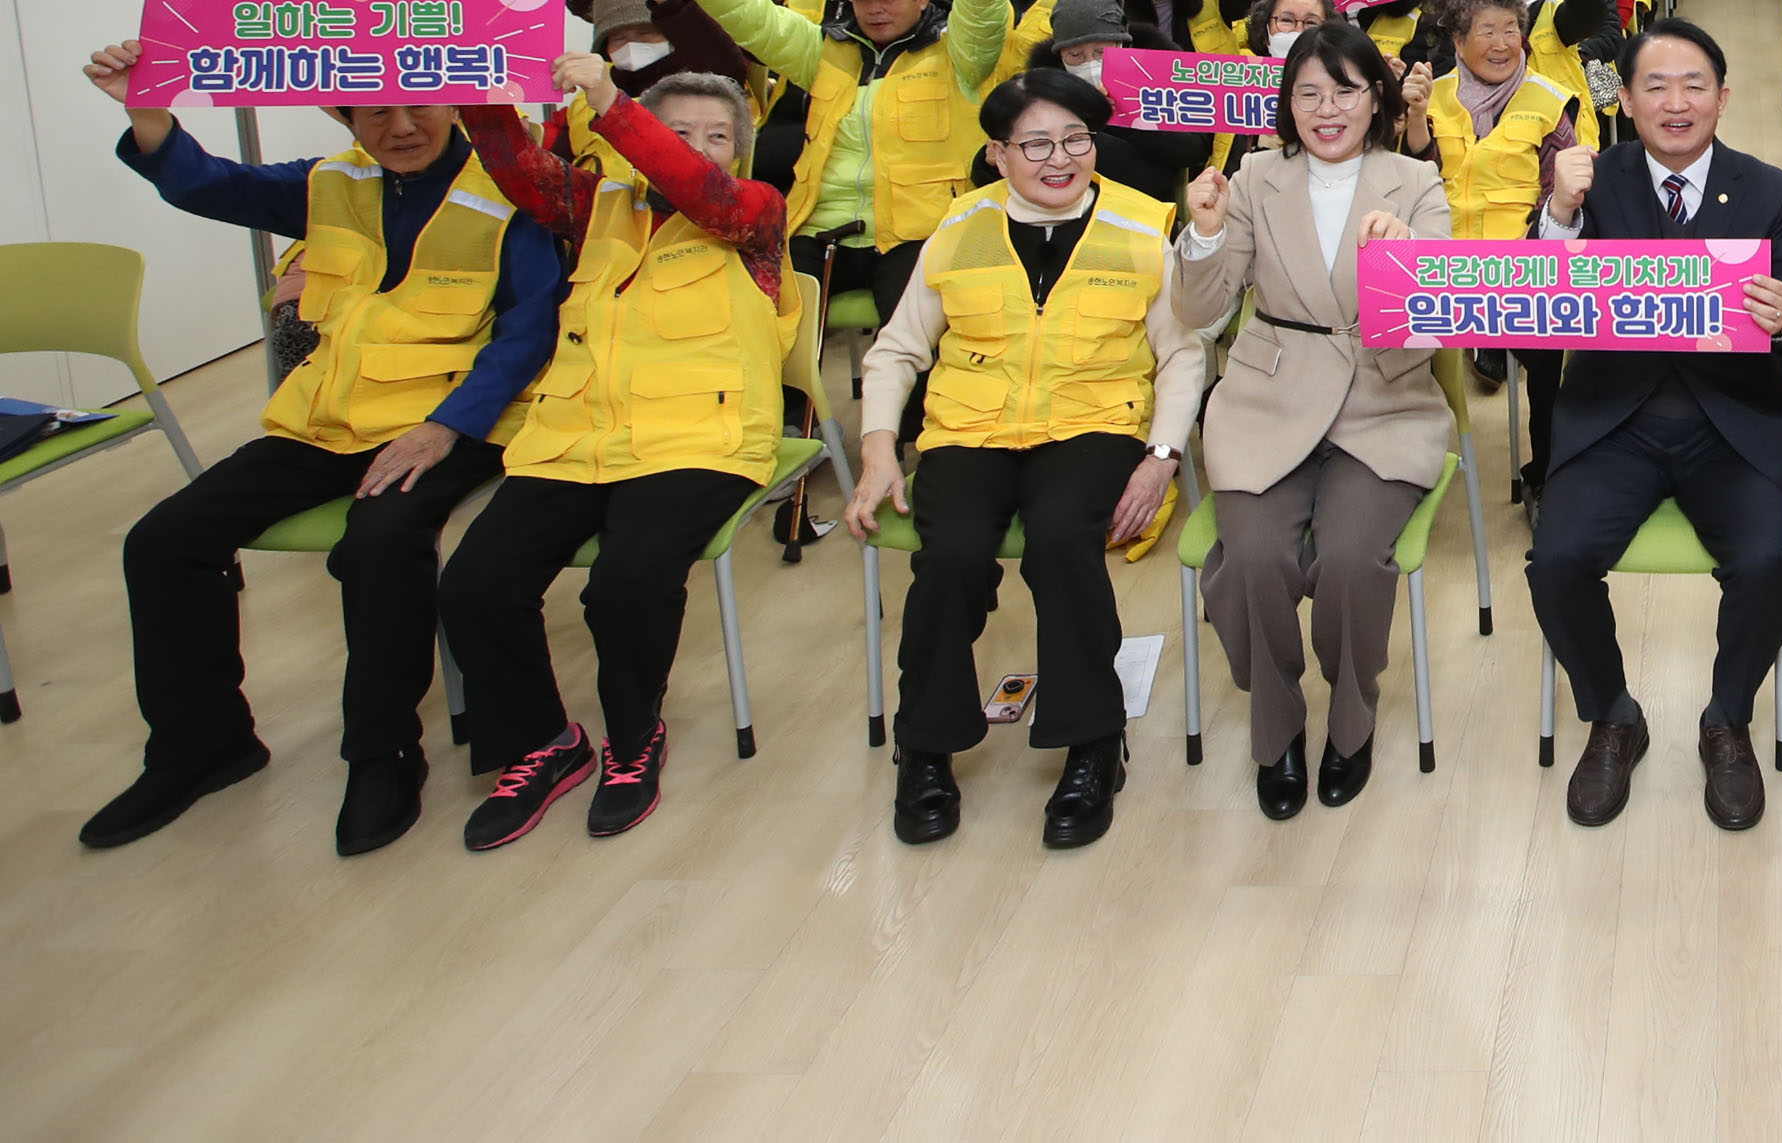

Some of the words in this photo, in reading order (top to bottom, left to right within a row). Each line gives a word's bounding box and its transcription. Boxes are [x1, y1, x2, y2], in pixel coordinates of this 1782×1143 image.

[233, 1, 357, 39] 일하는
[369, 1, 463, 37] 기쁨!
[188, 46, 385, 93] 함께하는
[396, 44, 507, 91] 행복!
[1140, 87, 1216, 125] 밝은
[1416, 256, 1557, 288] 건강하게!
[1569, 256, 1712, 288] 활기차게!
[1406, 292, 1601, 336] 일자리와
[1609, 293, 1722, 337] 함께!
